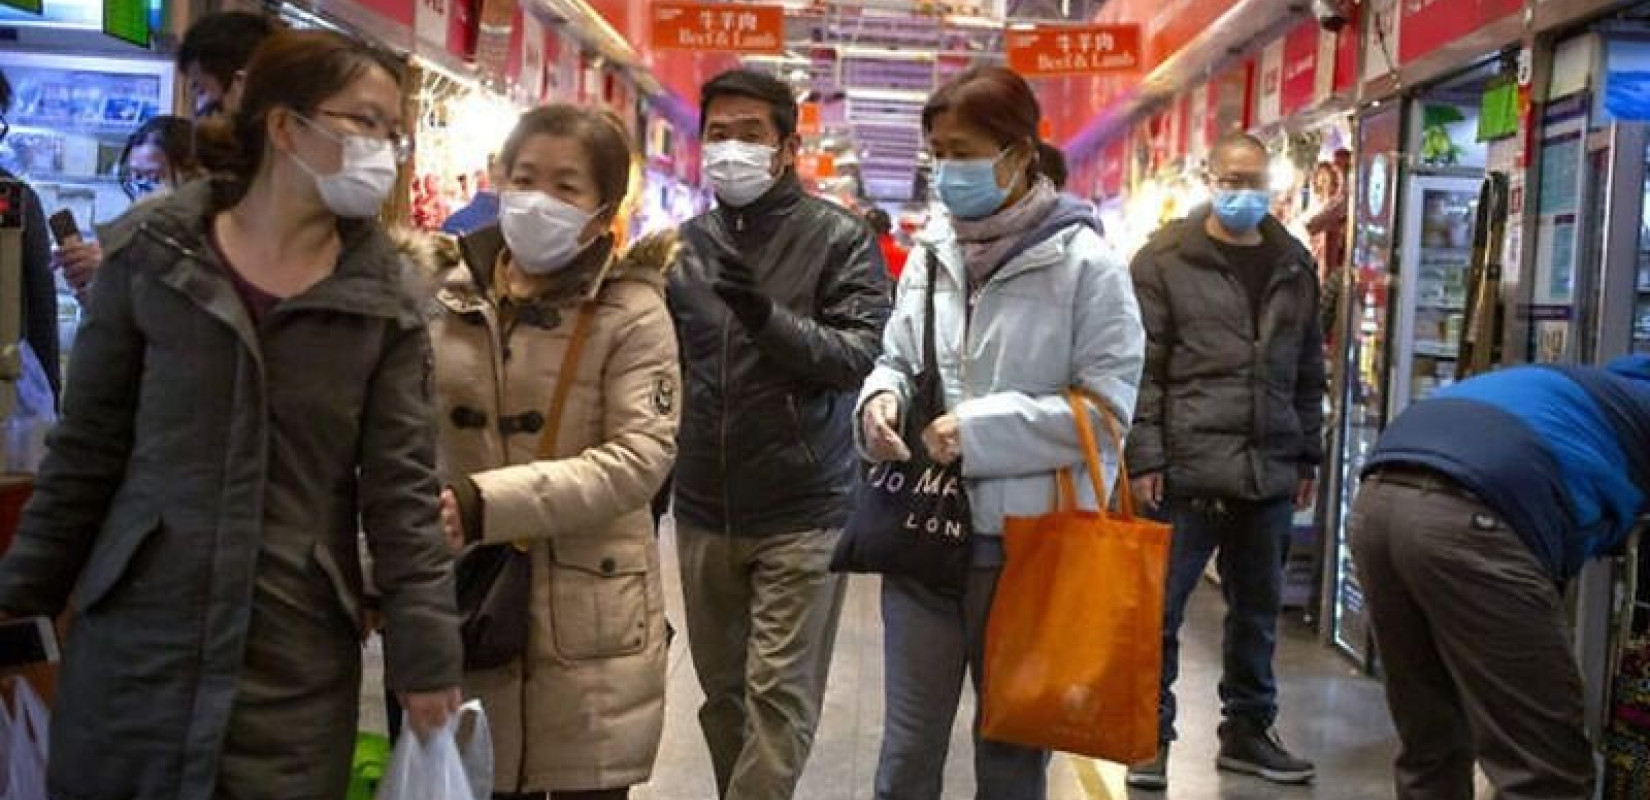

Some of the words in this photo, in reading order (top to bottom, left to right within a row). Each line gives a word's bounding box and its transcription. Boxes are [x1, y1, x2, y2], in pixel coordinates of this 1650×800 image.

[699, 10, 758, 31] 牛羊肉
[678, 28, 713, 46] Beef
[714, 30, 729, 47] &
[732, 30, 777, 48] Lamb
[1055, 32, 1115, 53] 牛羊肉
[1037, 52, 1073, 71] Beef
[1074, 53, 1089, 70] &
[1091, 50, 1135, 68] Lamb
